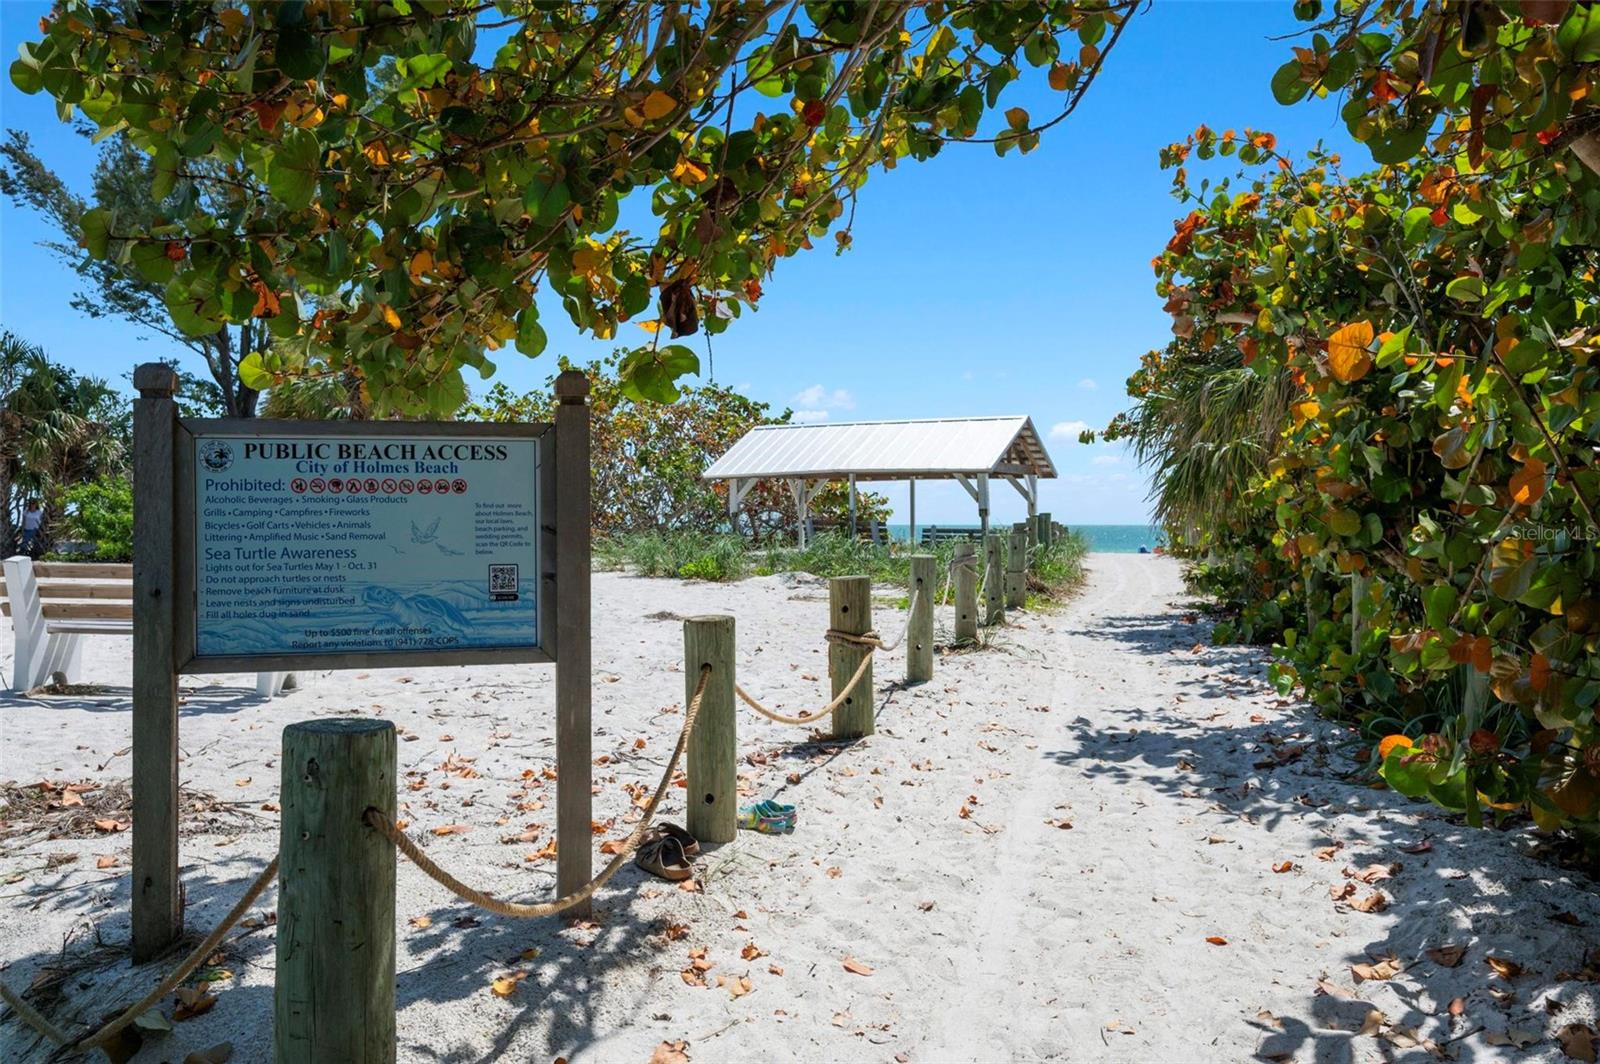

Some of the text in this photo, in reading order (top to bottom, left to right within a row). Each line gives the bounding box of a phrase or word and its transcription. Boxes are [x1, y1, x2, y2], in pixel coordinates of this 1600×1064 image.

[244, 443, 330, 459] PUBLIC
[338, 443, 416, 460] BEACH
[422, 444, 508, 461] ACCESS
[296, 461, 458, 476] City of Holmes Beach
[206, 479, 285, 492] Prohibited:
[205, 496, 245, 504] Alcoholic
[248, 496, 292, 505] Beverages
[302, 496, 340, 505] Smoking
[204, 508, 226, 516] Grills
[233, 508, 273, 518] Camping
[280, 508, 323, 518] Campfires
[205, 521, 371, 531] Bicycles Golf Carts Vehicles Animals
[205, 532, 386, 544] Littering Amplified Music Sand Removal
[205, 547, 357, 560] Sea Turtle Awareness
[206, 564, 232, 573] Lights
[252, 563, 264, 571] for
[266, 563, 282, 571] Sea
[284, 563, 313, 571] Turtles
[315, 563, 335, 572] May
[348, 562, 365, 570] Oct.
[238, 575, 280, 585] approach
[244, 586, 271, 595] beach
[273, 586, 310, 594] furniture
[303, 597, 355, 605] undisturbed
[260, 610, 276, 620] dug
[371, 627, 382, 635] for
[398, 627, 432, 635] offenses
[292, 641, 321, 649] Report
[323, 640, 339, 648] any
[341, 639, 382, 647] violations
[395, 638, 416, 647] (941)
